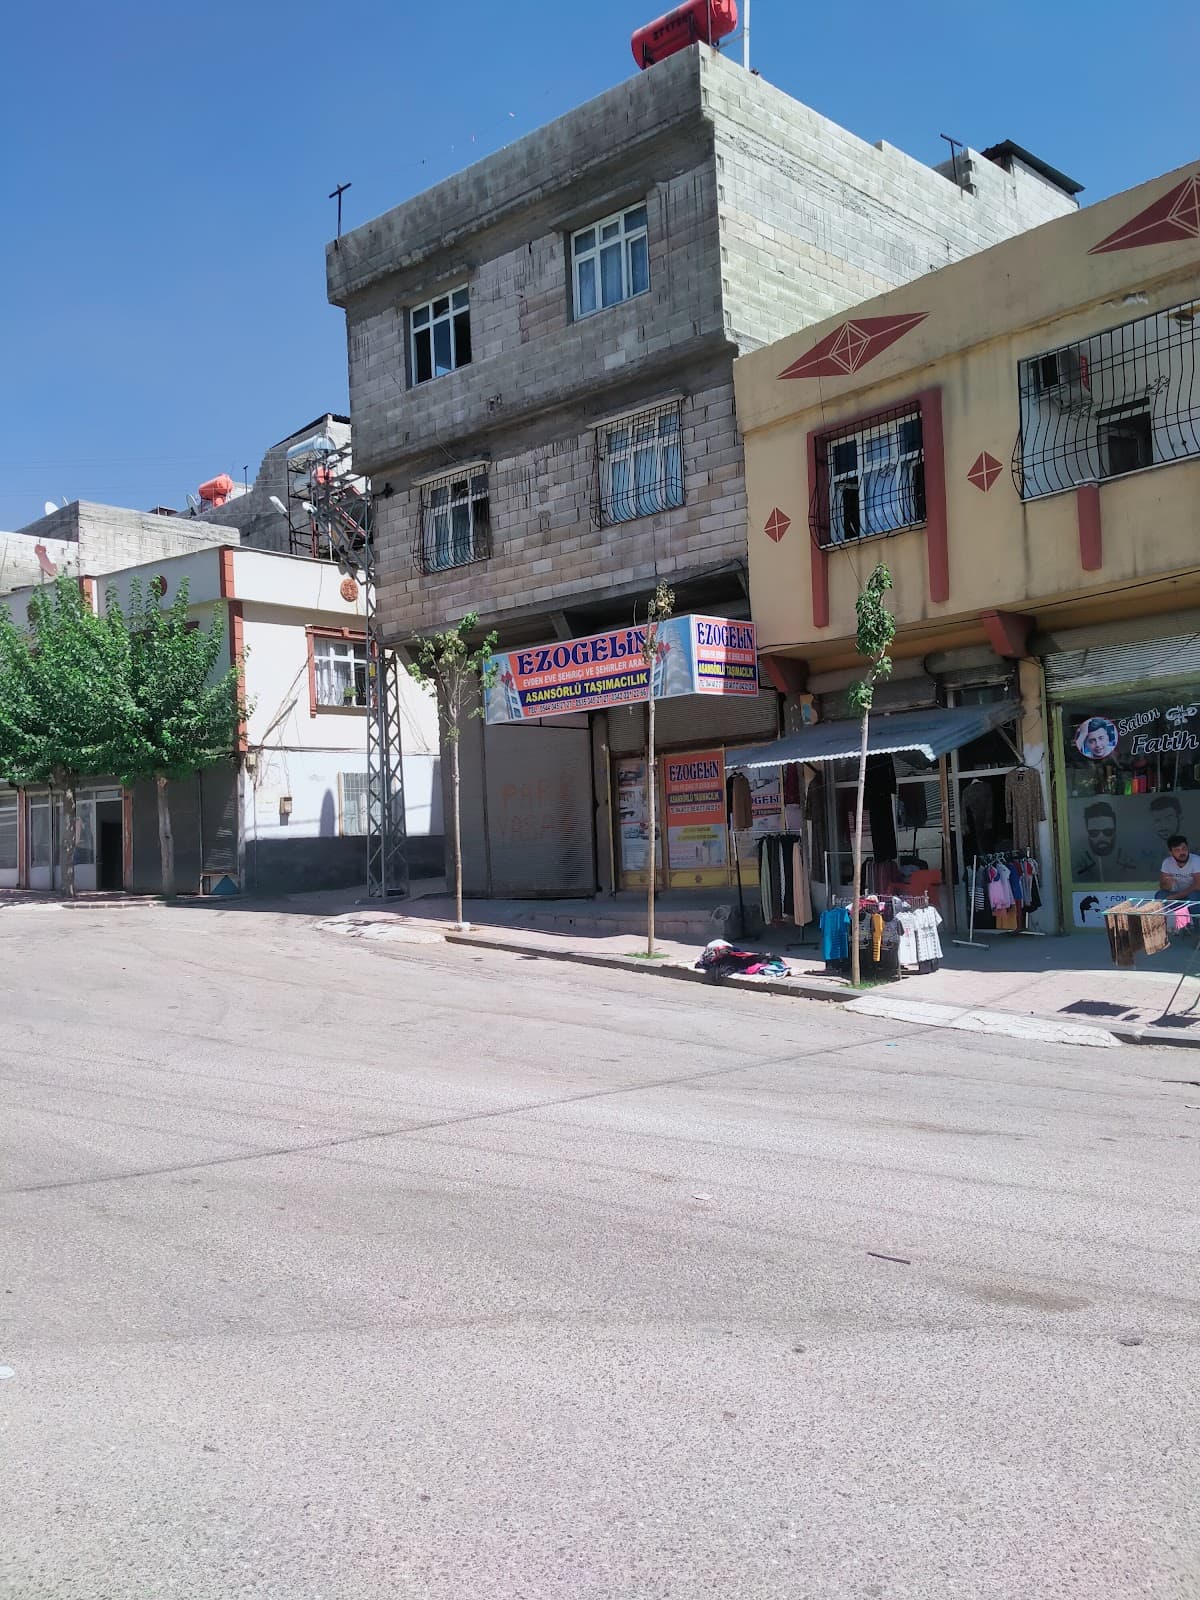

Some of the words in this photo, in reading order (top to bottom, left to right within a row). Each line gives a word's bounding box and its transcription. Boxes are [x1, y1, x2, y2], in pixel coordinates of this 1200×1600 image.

[526, 682, 582, 702] ASANSÖRLÜ
[584, 673, 648, 694] TAŞIMACILIK
[544, 673, 557, 684] EVE
[586, 667, 594, 676] VE
[1118, 707, 1160, 736] Salon
[1131, 730, 1200, 755] Fatih
